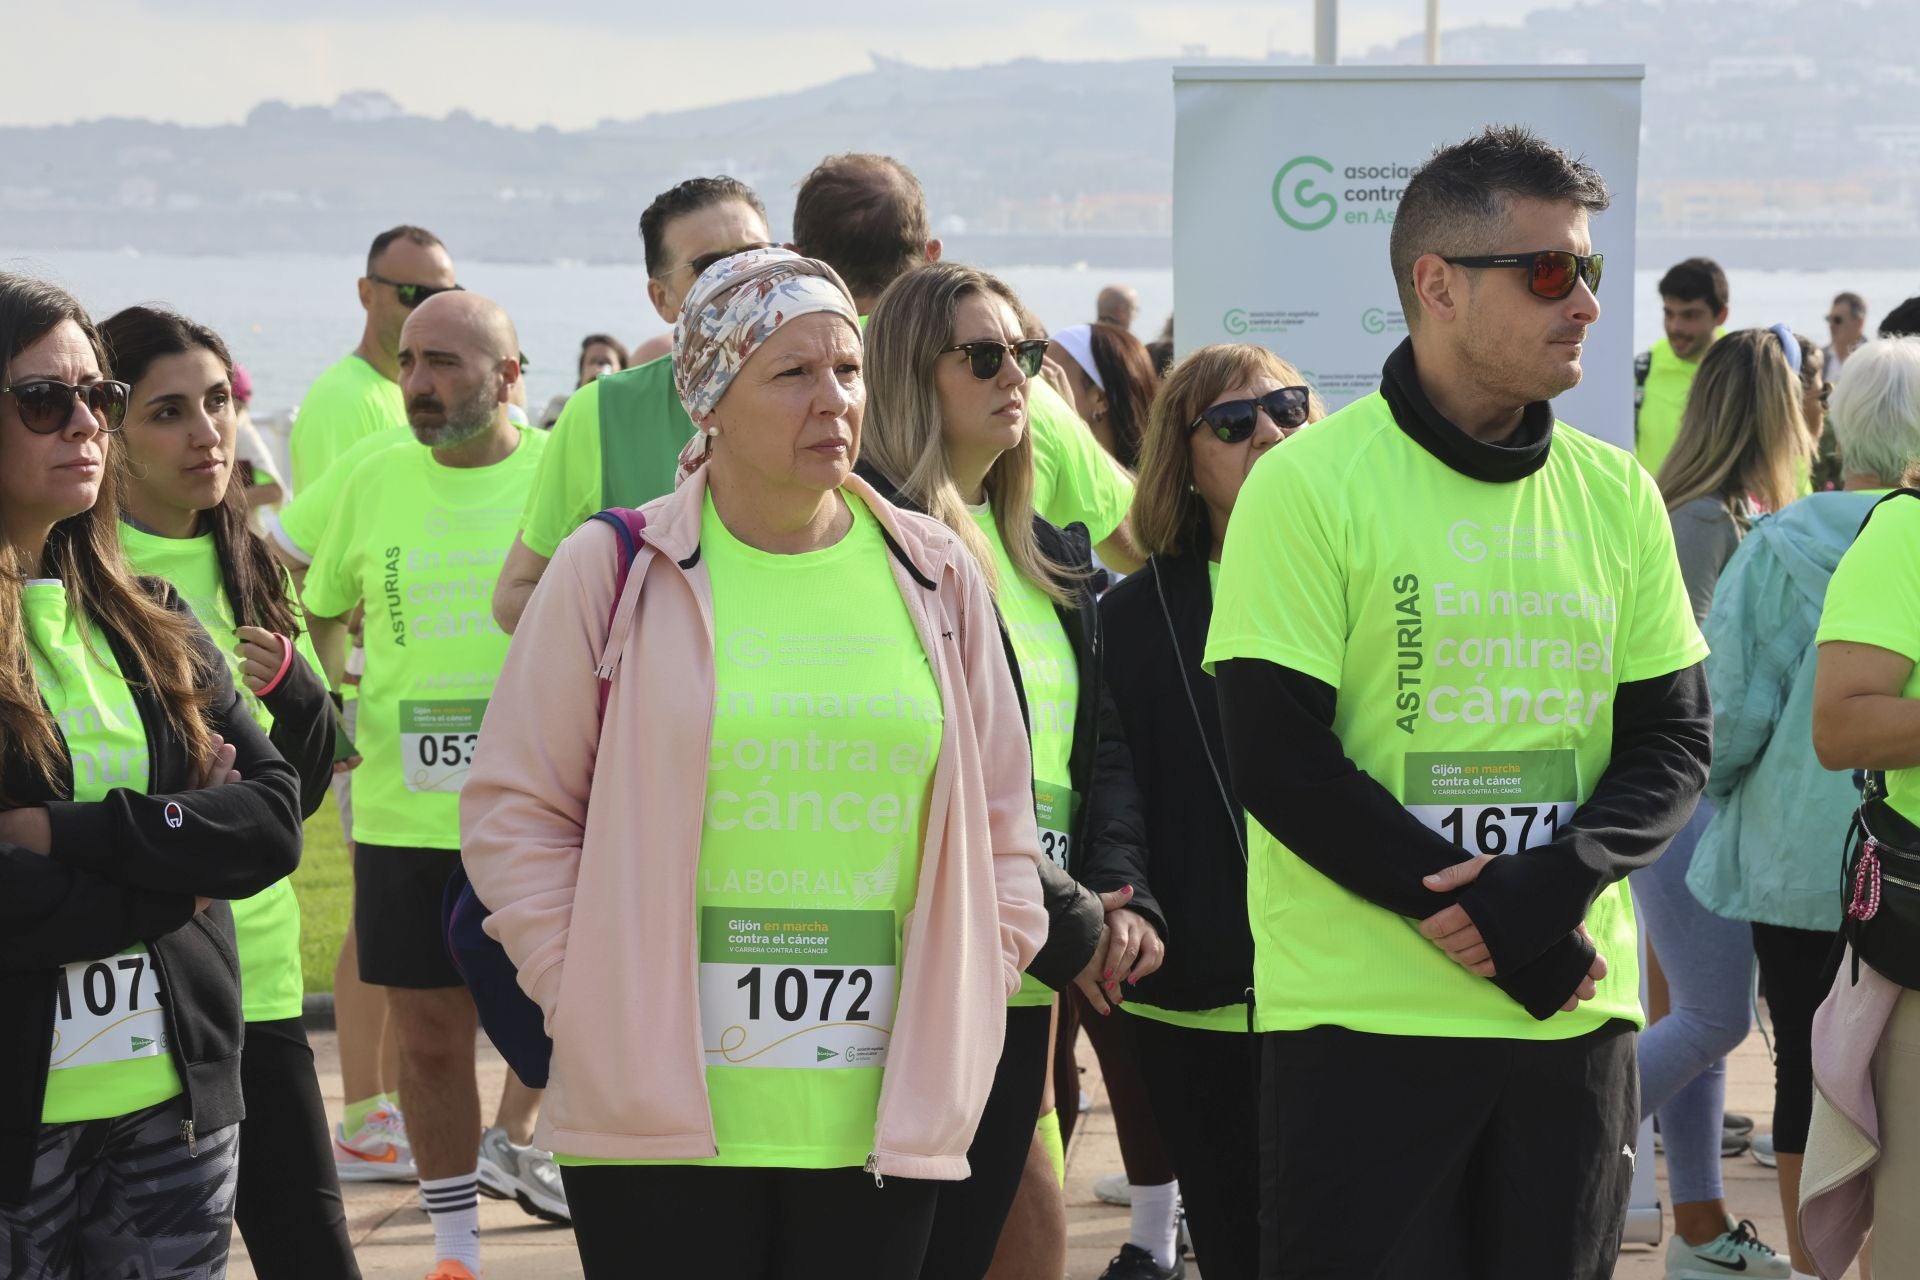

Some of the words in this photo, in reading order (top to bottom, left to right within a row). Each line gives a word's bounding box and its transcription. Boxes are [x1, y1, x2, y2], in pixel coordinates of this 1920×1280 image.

[1344, 211, 1369, 224] en
[407, 549, 440, 572] En
[448, 549, 505, 569] mar
[385, 546, 406, 647] ASTURIAS
[1433, 582, 1481, 616] En
[1489, 583, 1617, 623] marcha
[1393, 573, 1423, 735] ASTURIAS
[1435, 630, 1572, 670] contra
[1576, 634, 1613, 673] el
[770, 687, 943, 725] marcha
[1426, 672, 1610, 726] cáncer
[708, 730, 878, 771] contra
[888, 735, 933, 776] el
[1431, 763, 1462, 777] Gijón
[1464, 766, 1479, 774] en
[1482, 763, 1521, 774] marcha
[1431, 777, 1470, 787] contra
[1472, 776, 1484, 786] el
[1487, 774, 1522, 786] cáncer
[705, 775, 920, 835] cáncer
[1441, 805, 1559, 856] 1671
[702, 868, 848, 896] LABORAL
[728, 919, 761, 933] Gijón
[763, 922, 780, 932] en
[783, 920, 829, 932] marcha
[728, 933, 769, 944] contra
[772, 933, 785, 944] el
[787, 932, 829, 945] cáncer
[737, 966, 873, 1022] 1072
